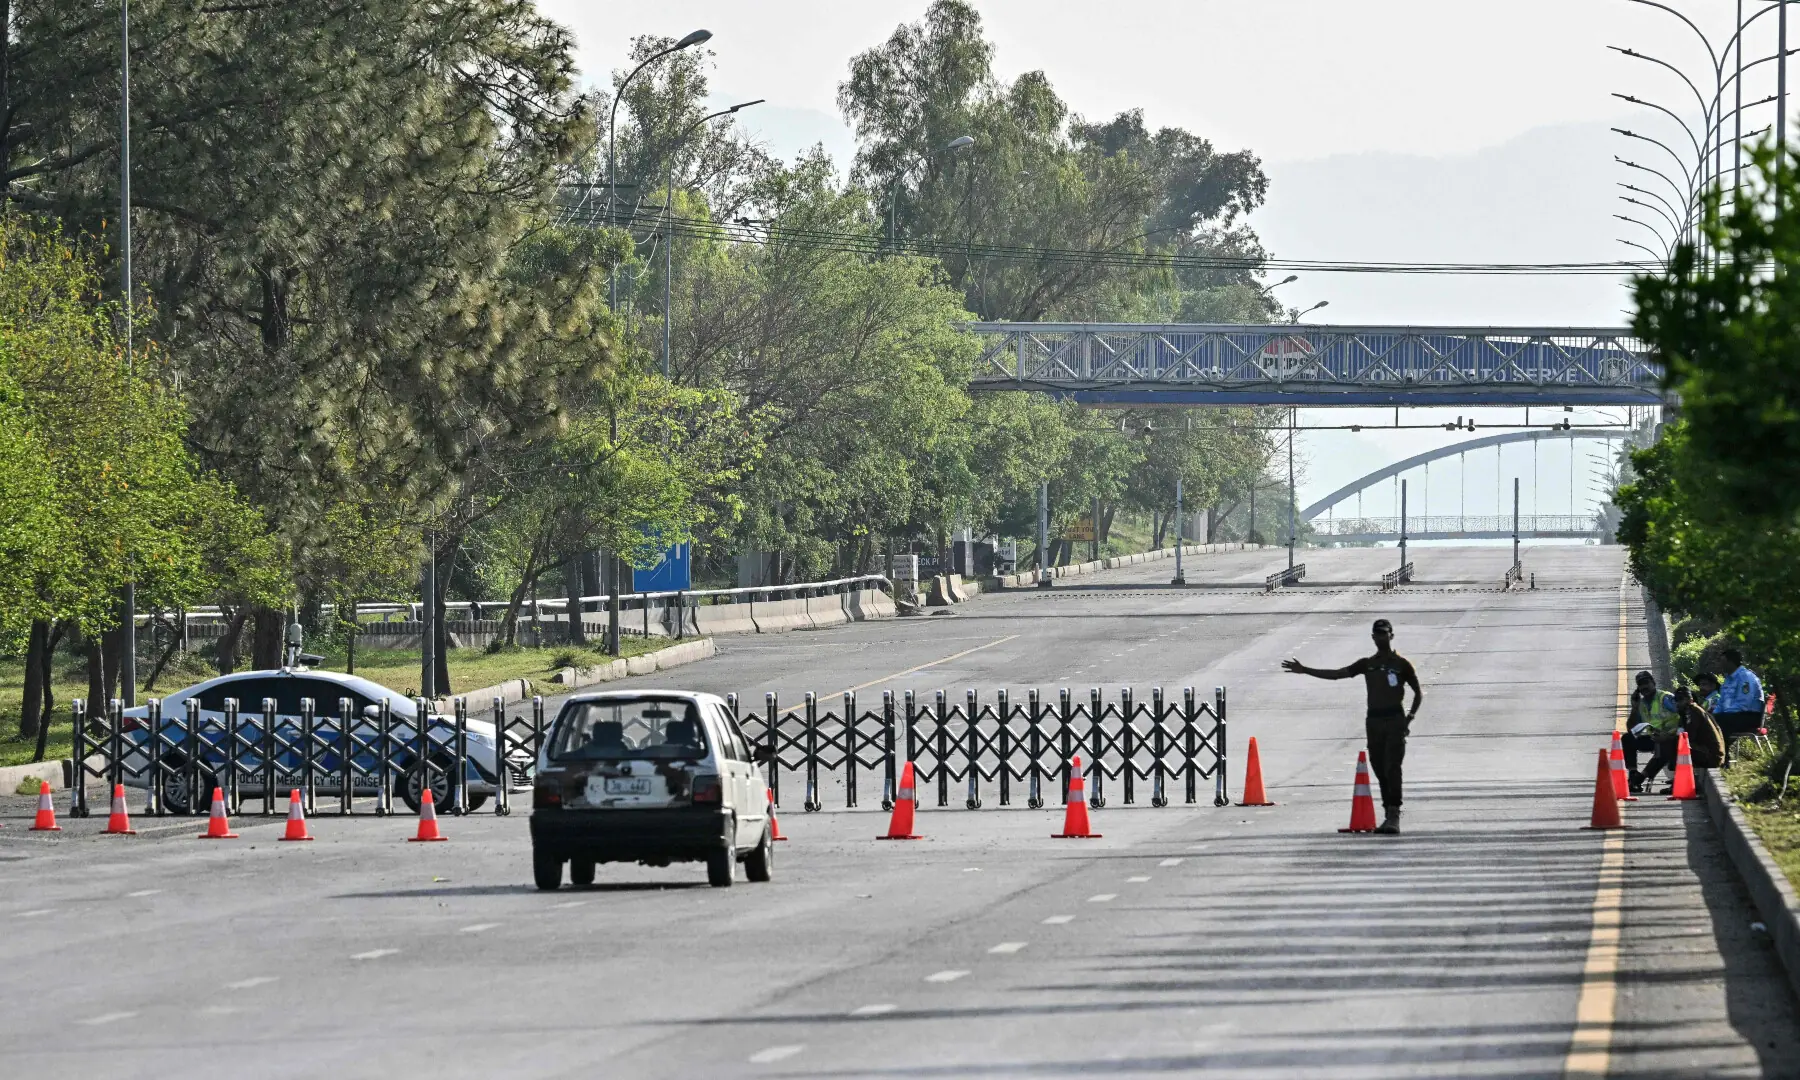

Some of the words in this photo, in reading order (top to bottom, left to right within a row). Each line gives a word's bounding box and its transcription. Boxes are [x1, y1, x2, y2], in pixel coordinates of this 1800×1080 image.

[1481, 369, 1505, 382] TO
[1513, 369, 1578, 382] SERVE
[237, 774, 265, 784] OLICE
